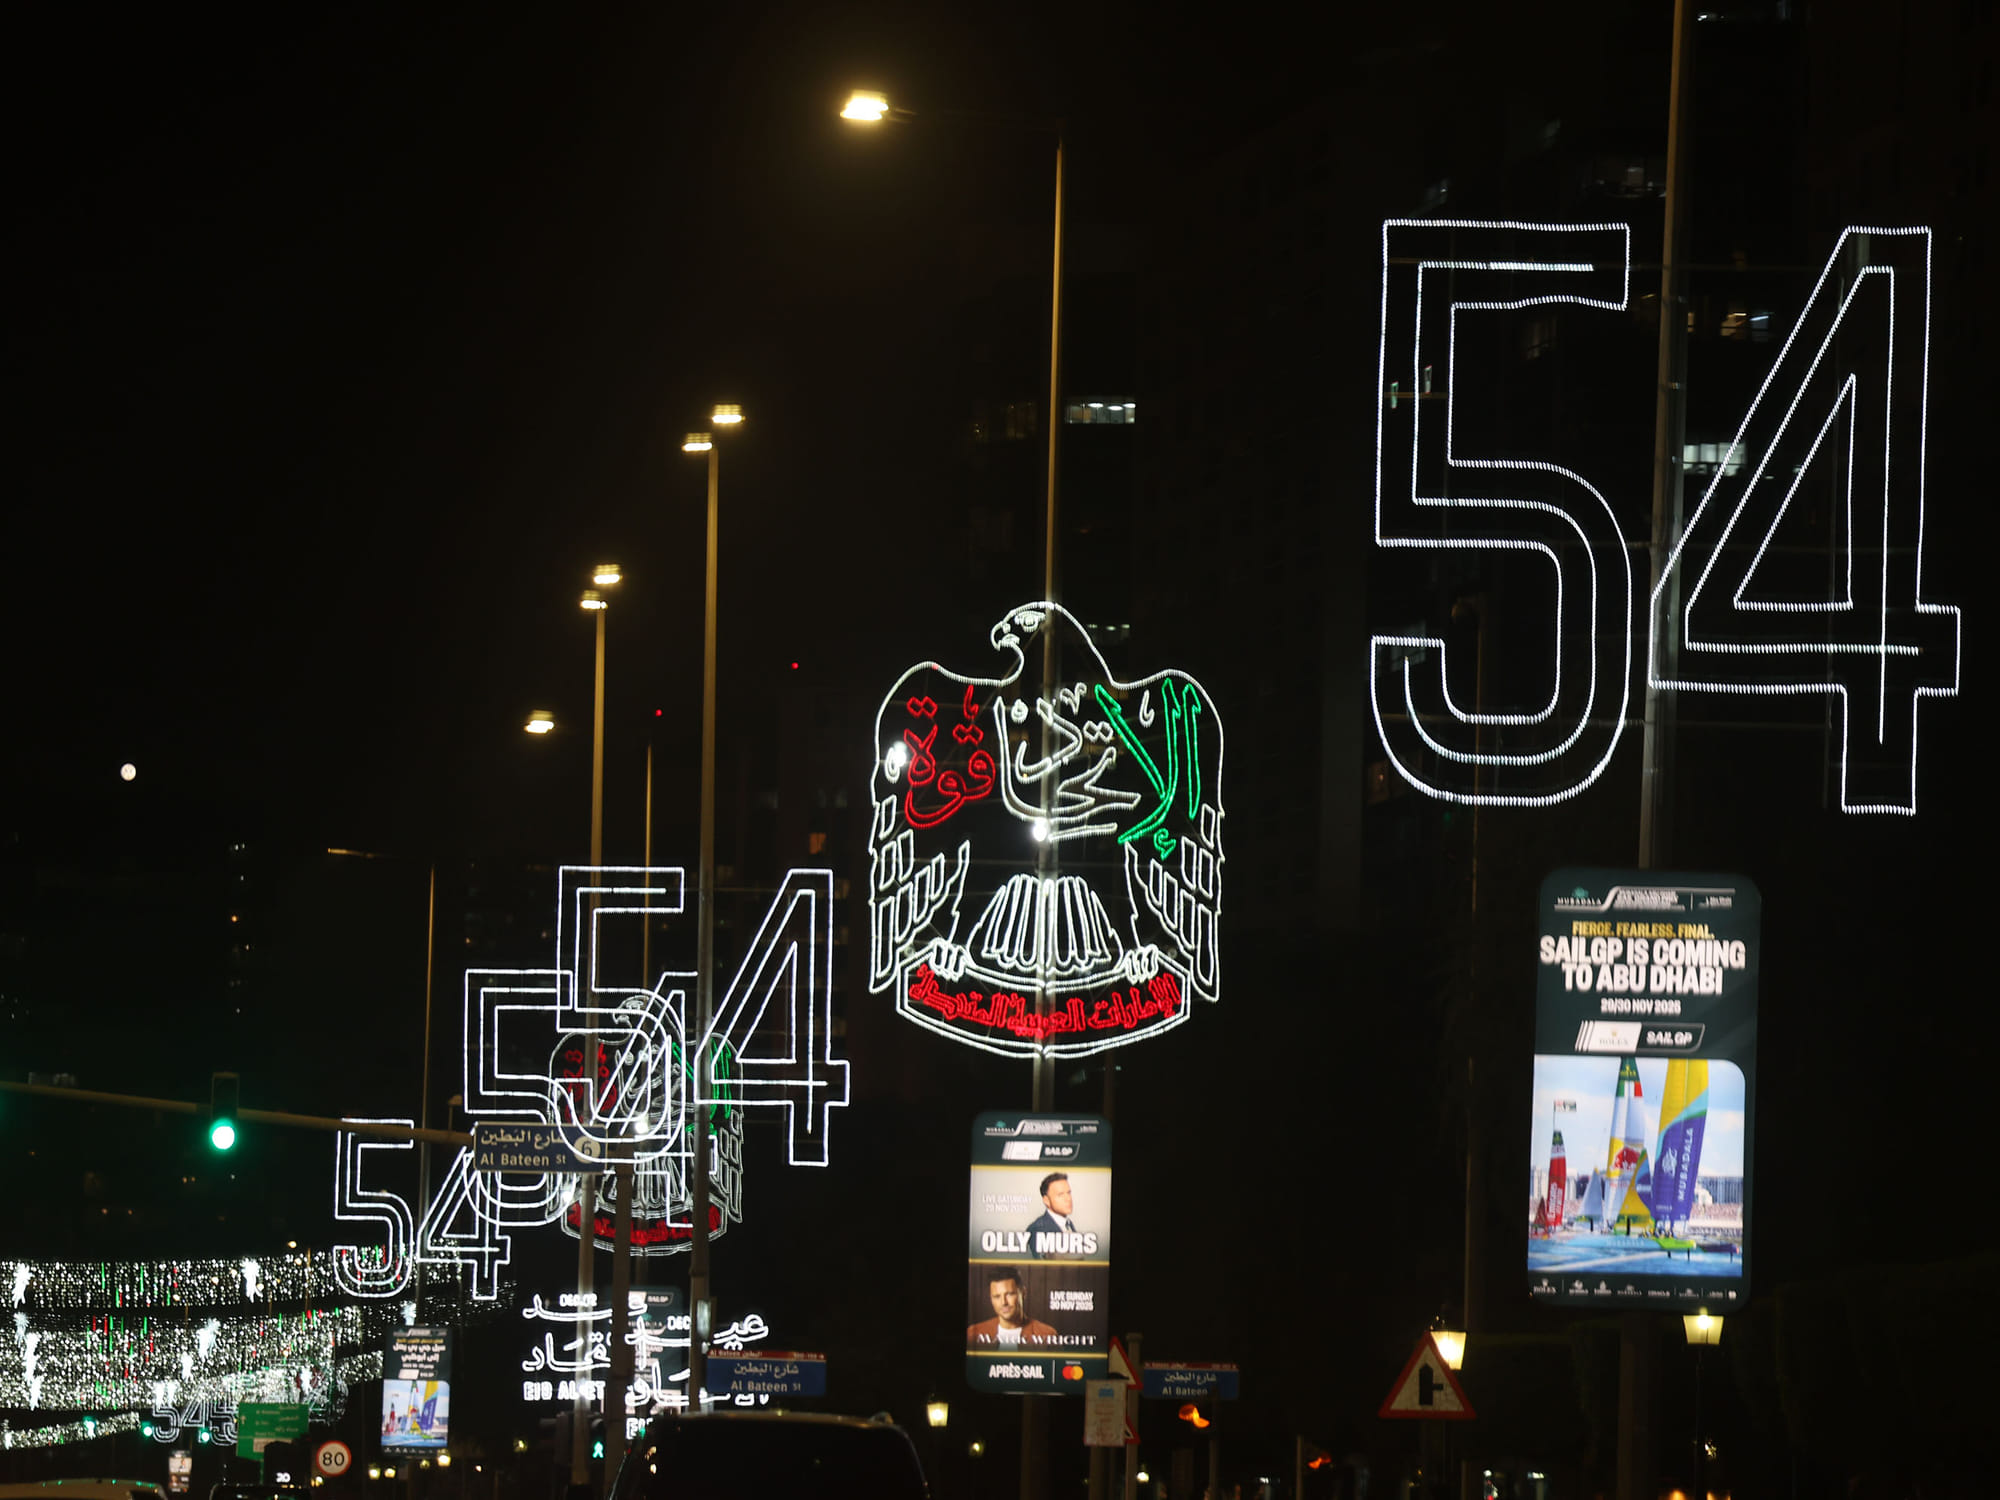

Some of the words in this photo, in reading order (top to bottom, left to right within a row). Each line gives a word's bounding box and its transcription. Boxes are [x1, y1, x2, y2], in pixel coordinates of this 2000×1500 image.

[1371, 218, 1960, 816] 54
[1572, 920, 1614, 938] FIERCE.
[1616, 923, 1676, 940] FEARLESS.
[1677, 923, 1715, 940] FINAL.
[1540, 935, 1623, 966] SAILGP
[1626, 938, 1649, 967] IS
[1653, 938, 1746, 970] COMING
[1562, 962, 1593, 991] TO
[1596, 963, 1648, 993] ABU
[1650, 964, 1723, 996] DHABI
[555, 865, 850, 1167] 54
[1632, 999, 1655, 1015] NOV
[581, 1140, 593, 1157] 6
[480, 1152, 494, 1165] Al
[501, 1153, 549, 1167] Bateen
[556, 1154, 566, 1165] St
[1676, 1127, 1694, 1201] MUBADALA
[332, 1118, 511, 1301] 54
[981, 1230, 1031, 1253] OLLY
[1035, 1231, 1098, 1254] MURS
[1050, 1290, 1066, 1300] LIVE
[1066, 1291, 1093, 1300] SUNDAY
[1061, 1301, 1075, 1310] NOV
[977, 1333, 1027, 1345] MARK
[1032, 1334, 1096, 1346] WRIGHT
[774, 1362, 799, 1379] شارع
[523, 1380, 553, 1401] EID
[731, 1380, 742, 1391] Al
[747, 1381, 788, 1392] Bateen
[322, 1452, 345, 1467] 80
